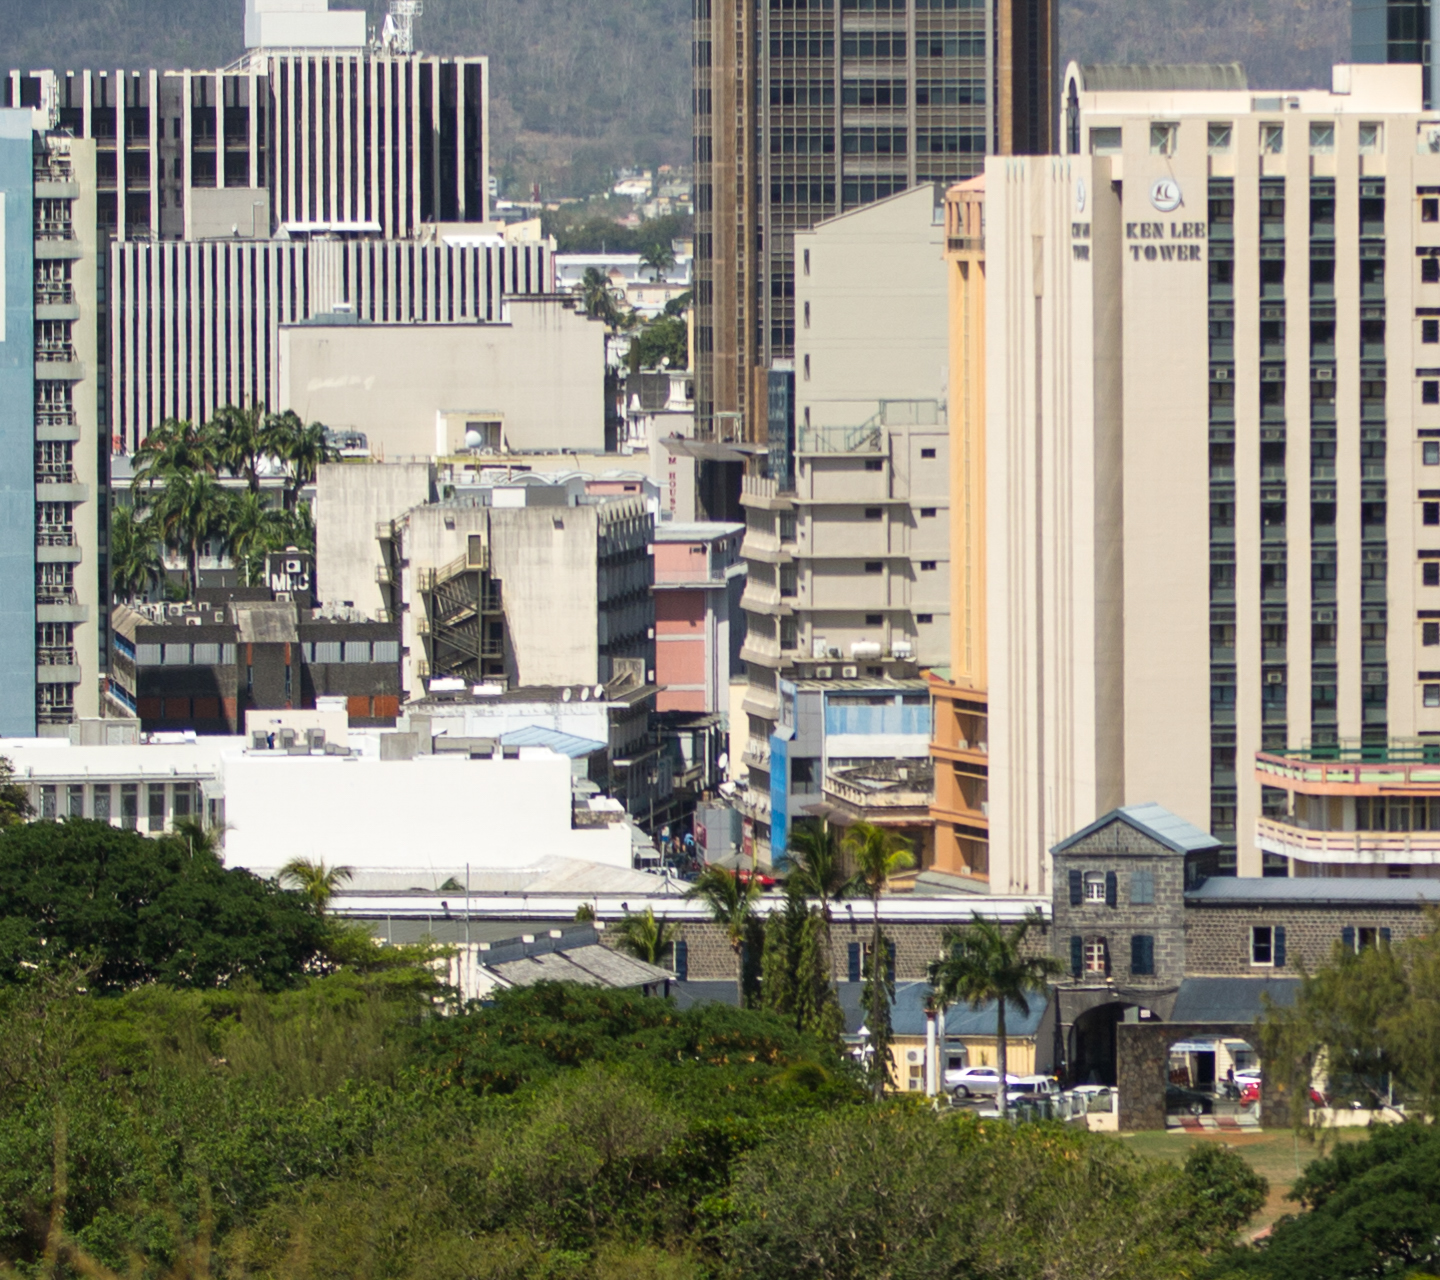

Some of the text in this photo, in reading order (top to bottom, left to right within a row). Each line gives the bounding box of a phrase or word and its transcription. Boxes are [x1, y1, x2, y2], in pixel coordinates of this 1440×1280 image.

[1126, 222, 1206, 239] KEN LEE
[1129, 245, 1202, 261] TOWER
